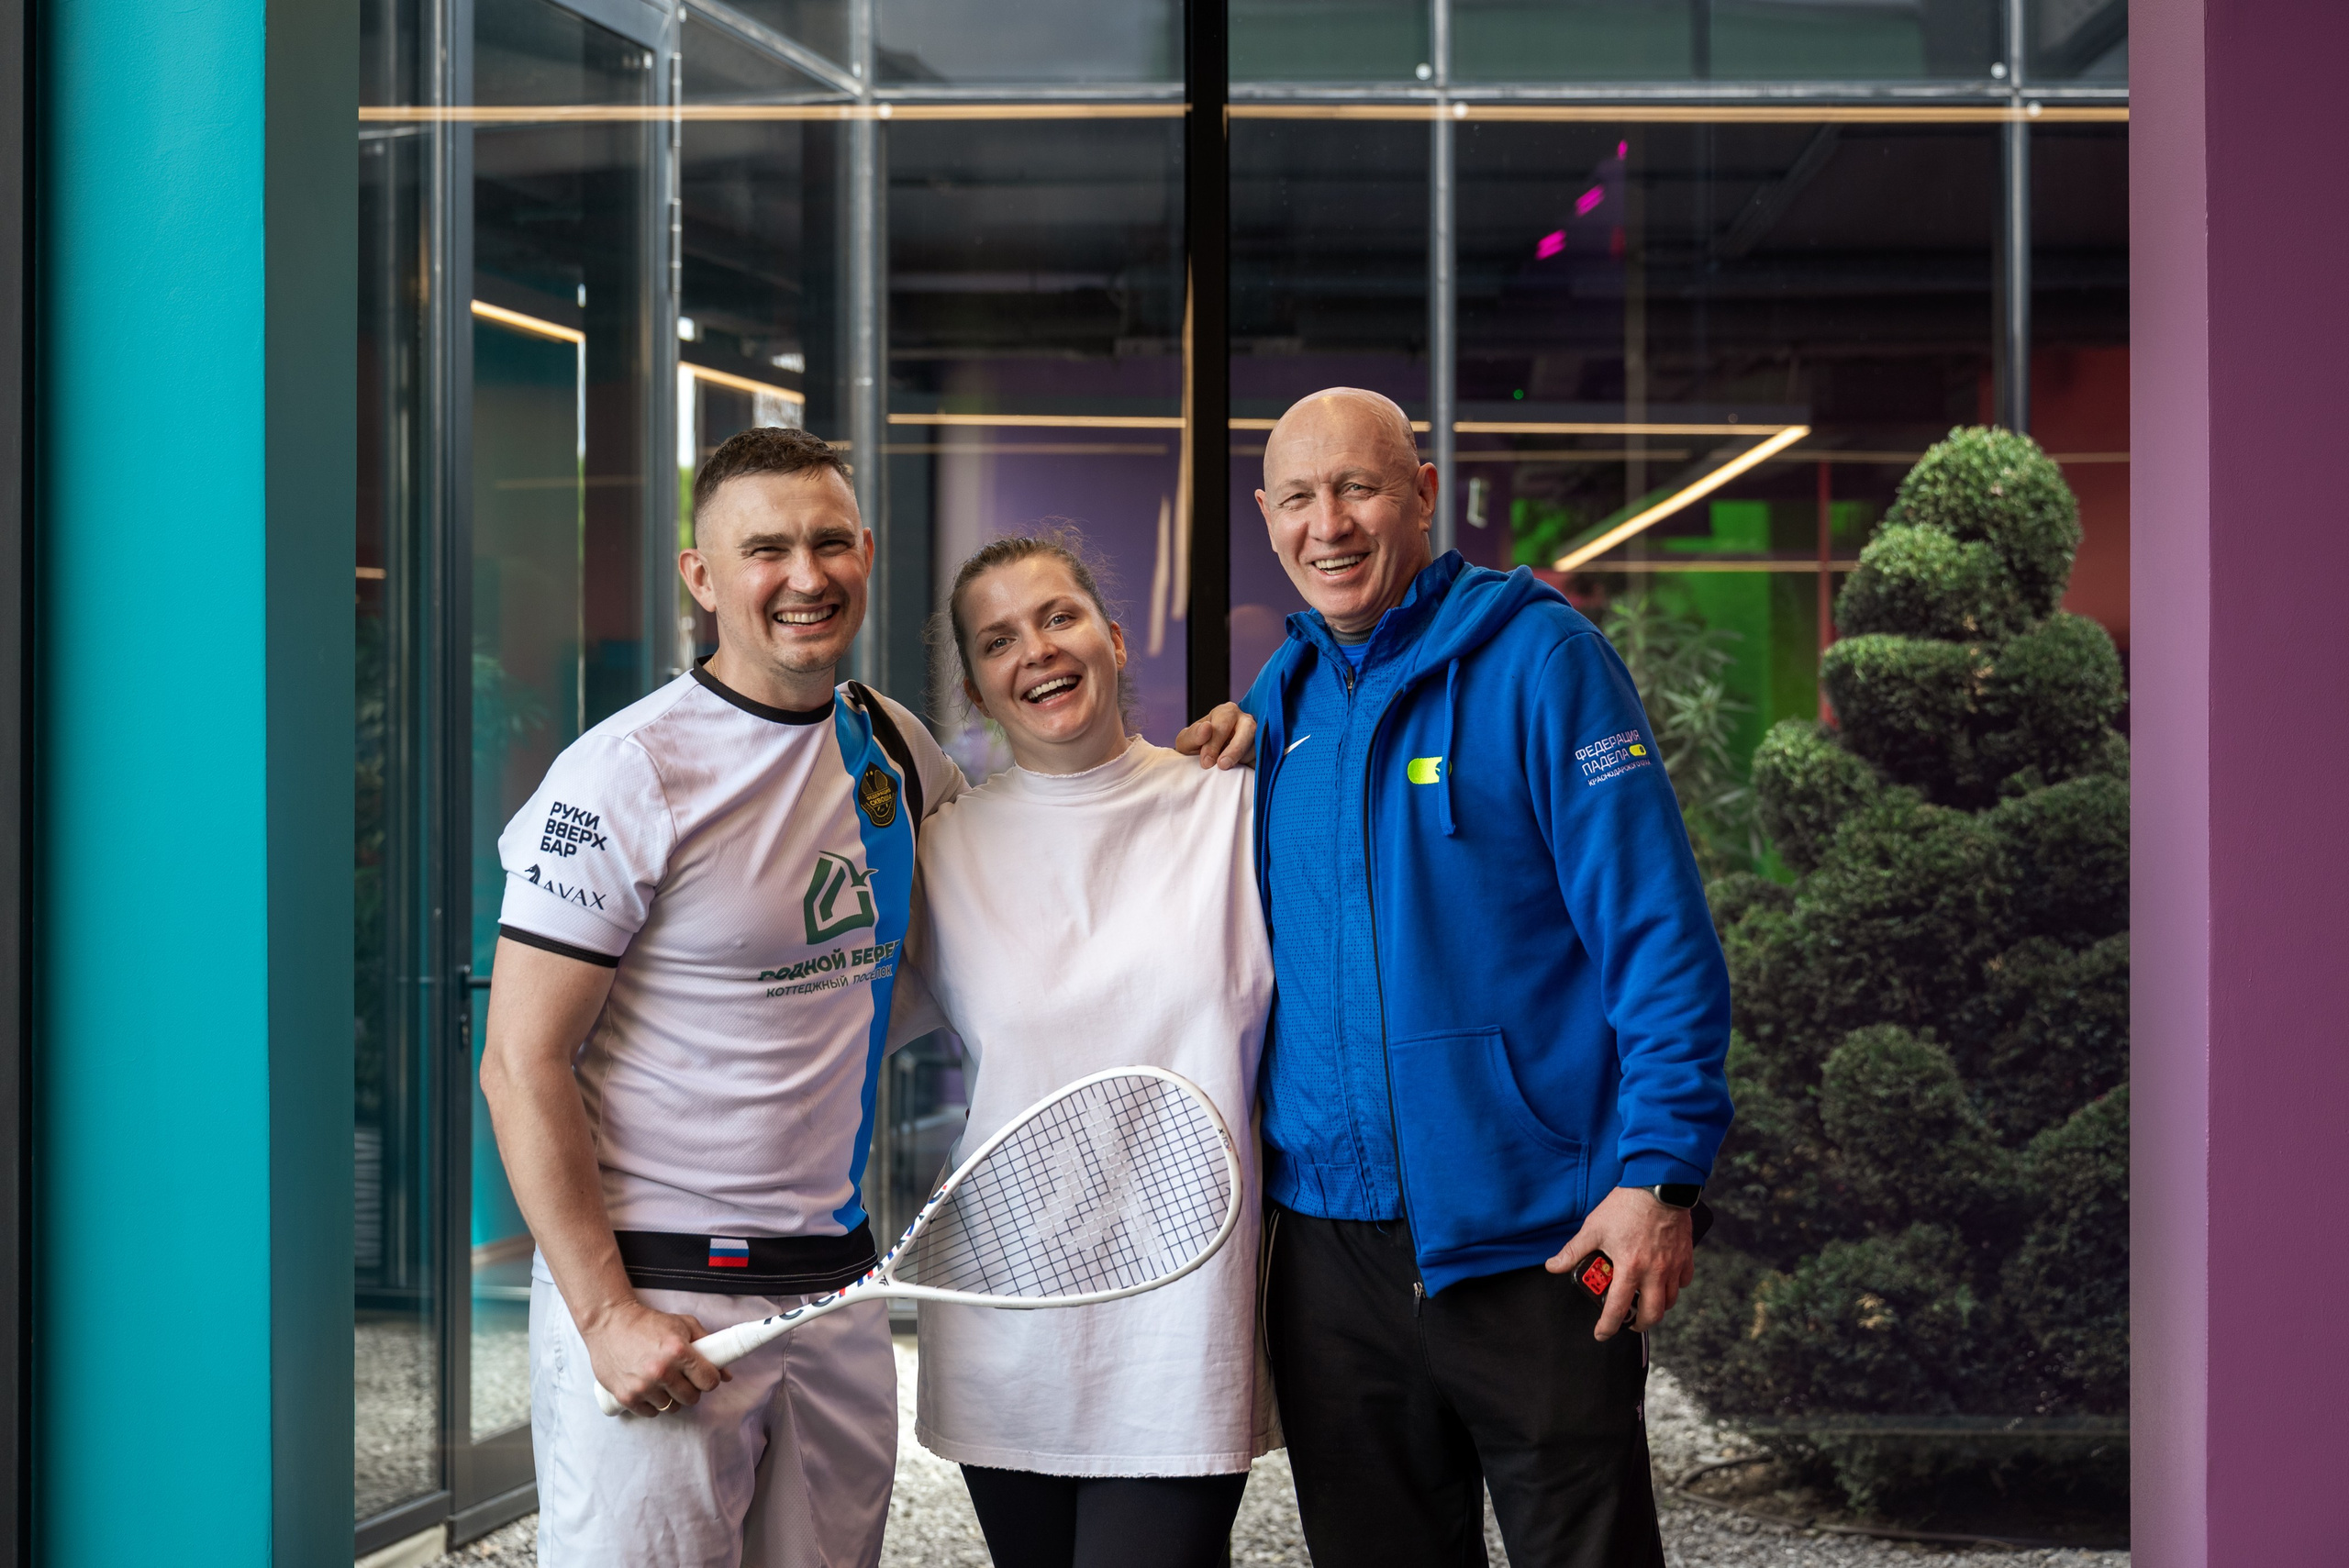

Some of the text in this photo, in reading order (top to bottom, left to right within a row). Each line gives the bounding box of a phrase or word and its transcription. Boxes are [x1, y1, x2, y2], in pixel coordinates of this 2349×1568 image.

[1575, 729, 1641, 761] ФЕДЕРАЦИЯ
[1581, 748, 1631, 776] ПАДЕЛА
[550, 801, 600, 830] РУКИ
[540, 836, 577, 858] БАР
[545, 818, 607, 851] ВВЕРХ
[543, 880, 607, 910] AVAX
[766, 974, 849, 998] КОТТЕДЖНЫЙ
